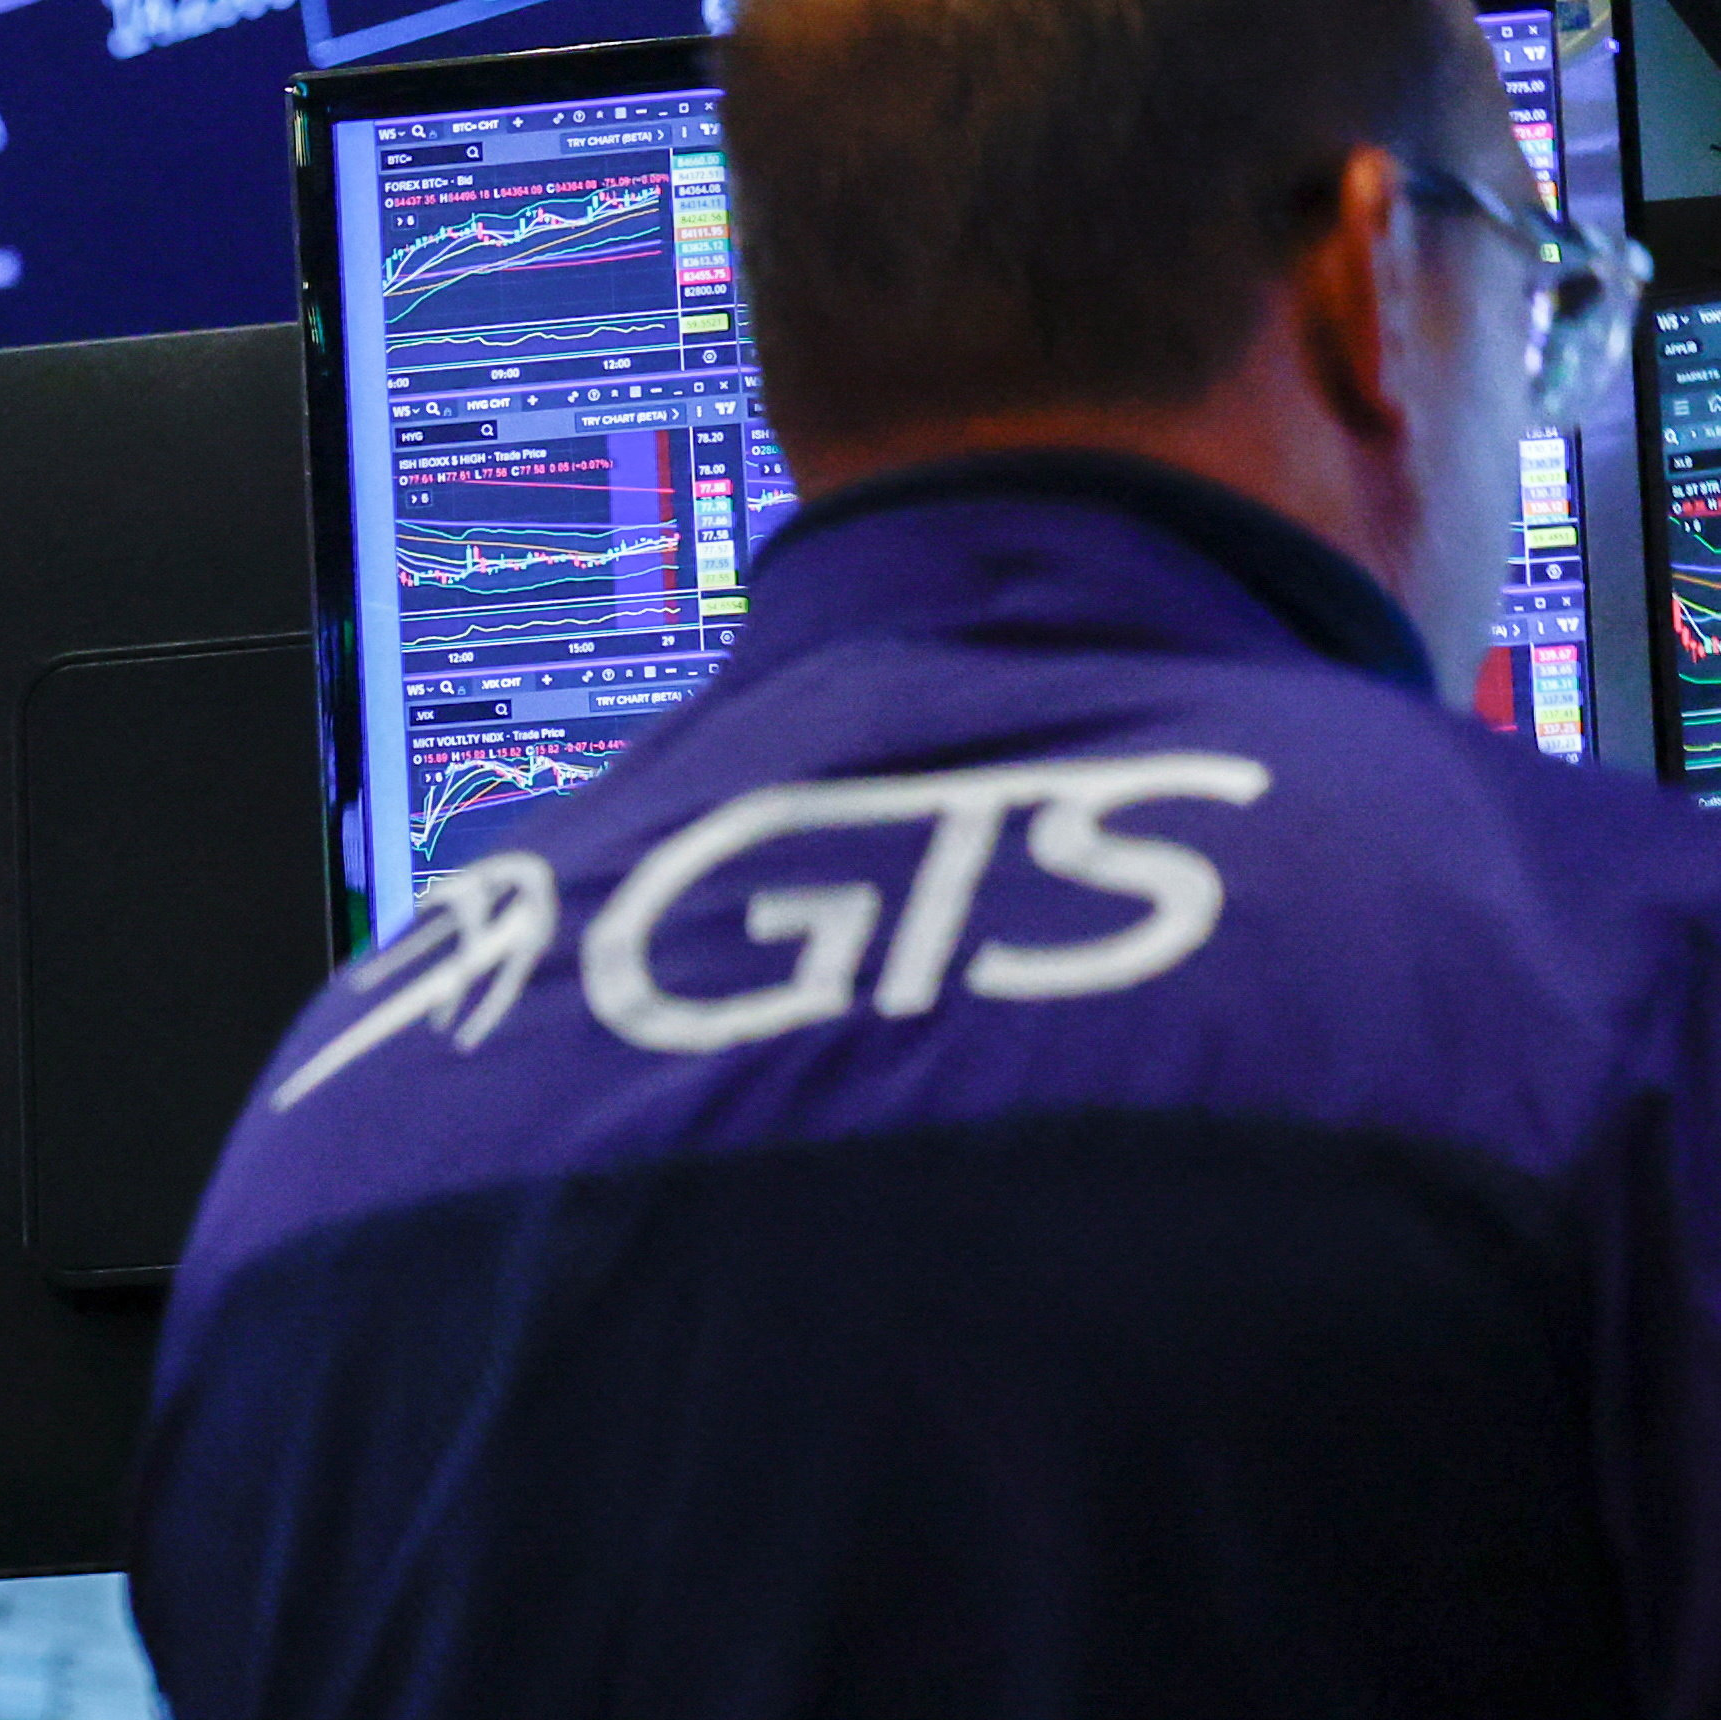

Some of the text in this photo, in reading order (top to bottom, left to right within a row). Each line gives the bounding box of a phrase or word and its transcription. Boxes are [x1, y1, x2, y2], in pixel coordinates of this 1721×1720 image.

[567, 131, 652, 148] TRY CHART (BETA)
[385, 180, 421, 193] FOREX
[457, 175, 474, 186] Bid
[603, 358, 632, 370] 12:00
[491, 367, 521, 380] 09:00
[392, 405, 411, 418] WS
[467, 399, 489, 411] HYG
[582, 410, 668, 427] TRY CHART (BETA)
[401, 430, 424, 443] HYG
[697, 431, 724, 444] 78.20
[399, 458, 417, 470] ISH
[418, 455, 451, 469] IBOXX
[460, 452, 486, 465] HIGH
[494, 449, 522, 462] Trade
[522, 448, 547, 460] Price
[698, 464, 726, 476] 78.00
[568, 641, 595, 654] 15:00
[661, 635, 676, 647] 29
[448, 651, 474, 664] 12:00
[596, 690, 683, 707] TRY CHART (BETA)
[412, 727, 566, 749] MKT VOLTLTY NDX Trade Price
[579, 753, 1270, 1055] GTS
